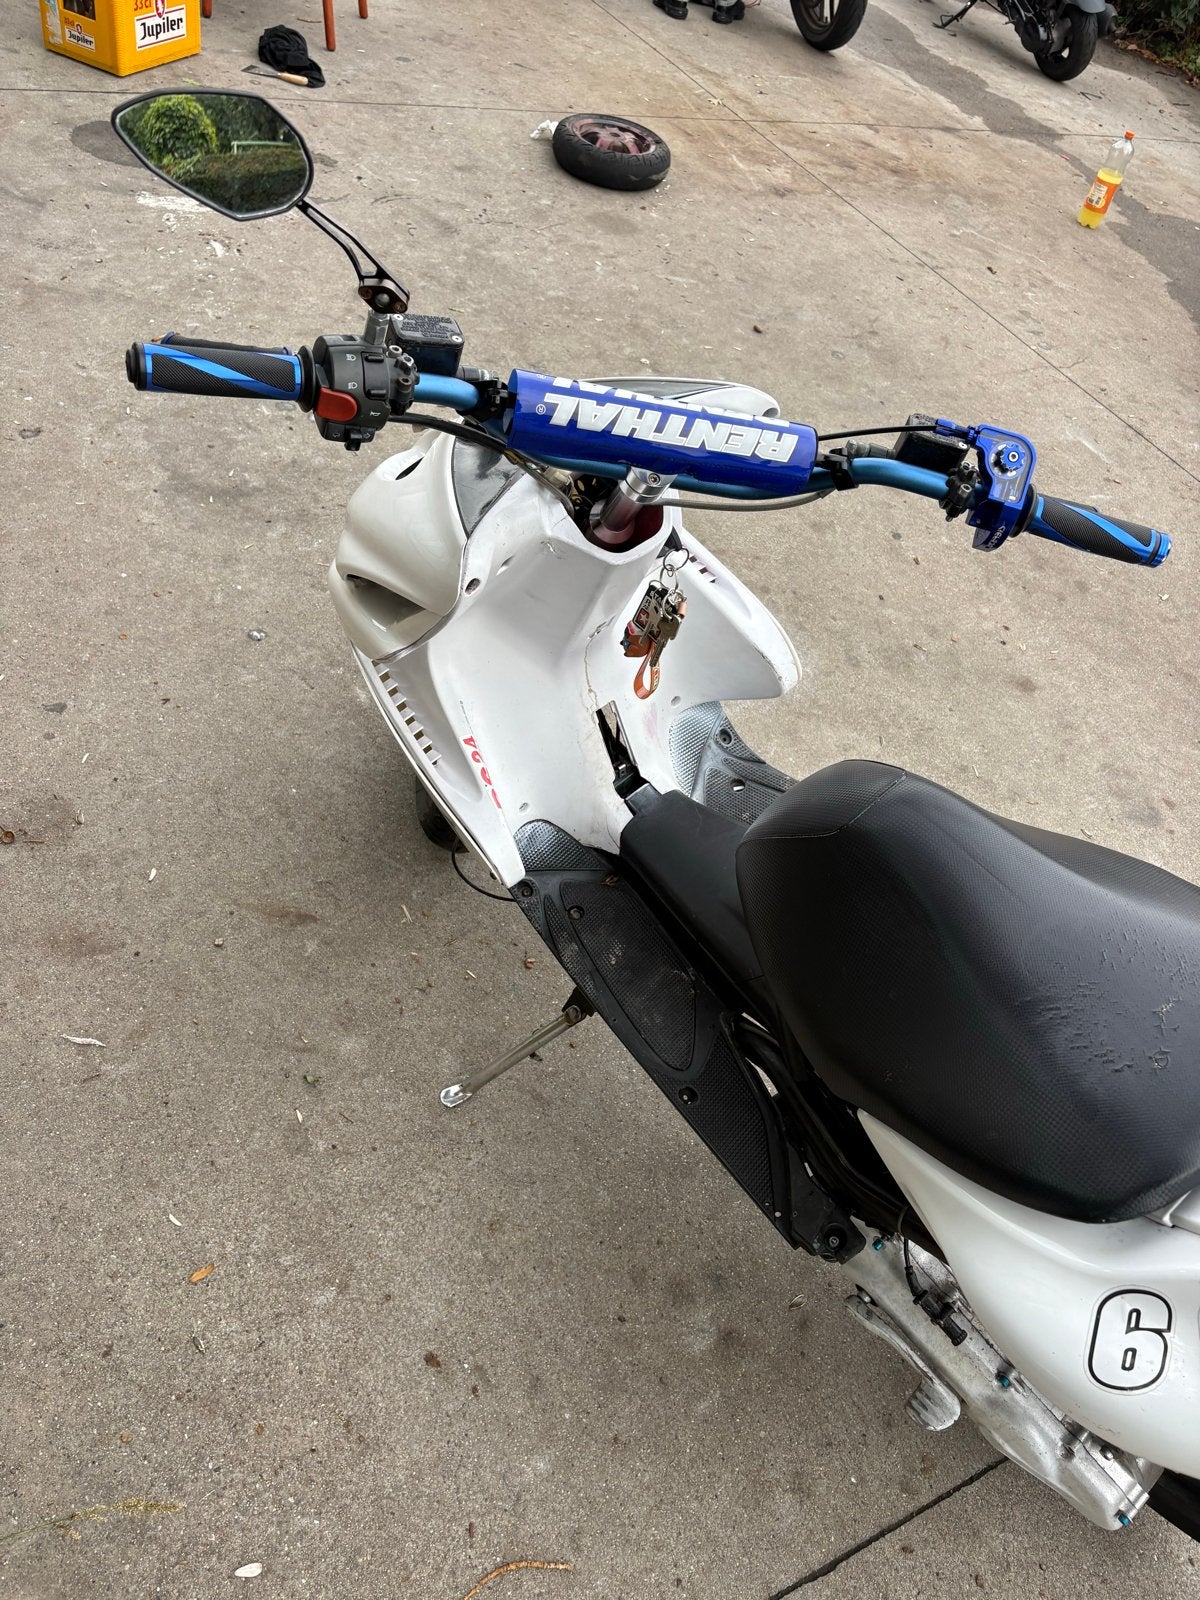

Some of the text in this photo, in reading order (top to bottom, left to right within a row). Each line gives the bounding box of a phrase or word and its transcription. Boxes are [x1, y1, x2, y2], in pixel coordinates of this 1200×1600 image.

[67, 29, 94, 46] Jupiler
[139, 16, 183, 40] Jupiler
[543, 392, 799, 463] RENTHAL
[1087, 1288, 1173, 1391] 6
